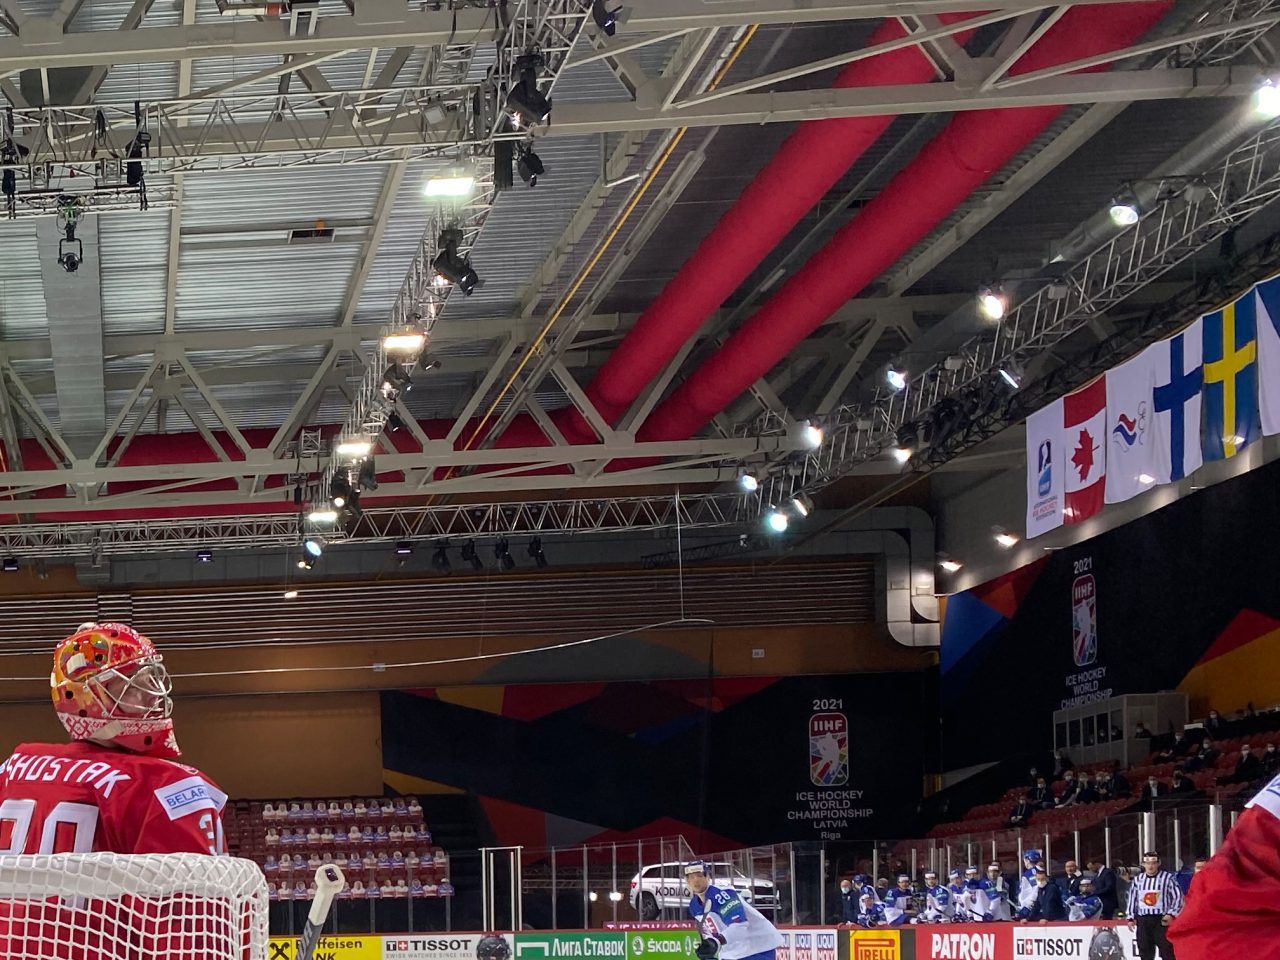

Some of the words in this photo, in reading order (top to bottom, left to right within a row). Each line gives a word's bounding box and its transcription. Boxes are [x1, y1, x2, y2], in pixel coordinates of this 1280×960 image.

[1074, 556, 1093, 575] 2021
[1075, 582, 1093, 599] IIHF
[1065, 674, 1077, 687] ICE
[1078, 666, 1107, 684] HOCKEY
[1073, 680, 1099, 696] WORLD
[812, 699, 843, 710] 2021
[813, 720, 843, 731] IIHF
[166, 787, 206, 807] BELAR
[796, 792, 815, 801] ICE
[817, 791, 864, 800] HOCKEY
[809, 800, 851, 809] WORLD
[787, 809, 874, 820] CHAMPIONSHIP
[813, 820, 848, 829] LATVIA
[821, 831, 841, 840] Riga
[655, 886, 691, 898] KODIAQ
[410, 939, 471, 951] TISSOT
[647, 938, 682, 953] ŠKODA
[1034, 939, 1083, 956] TISSOT
